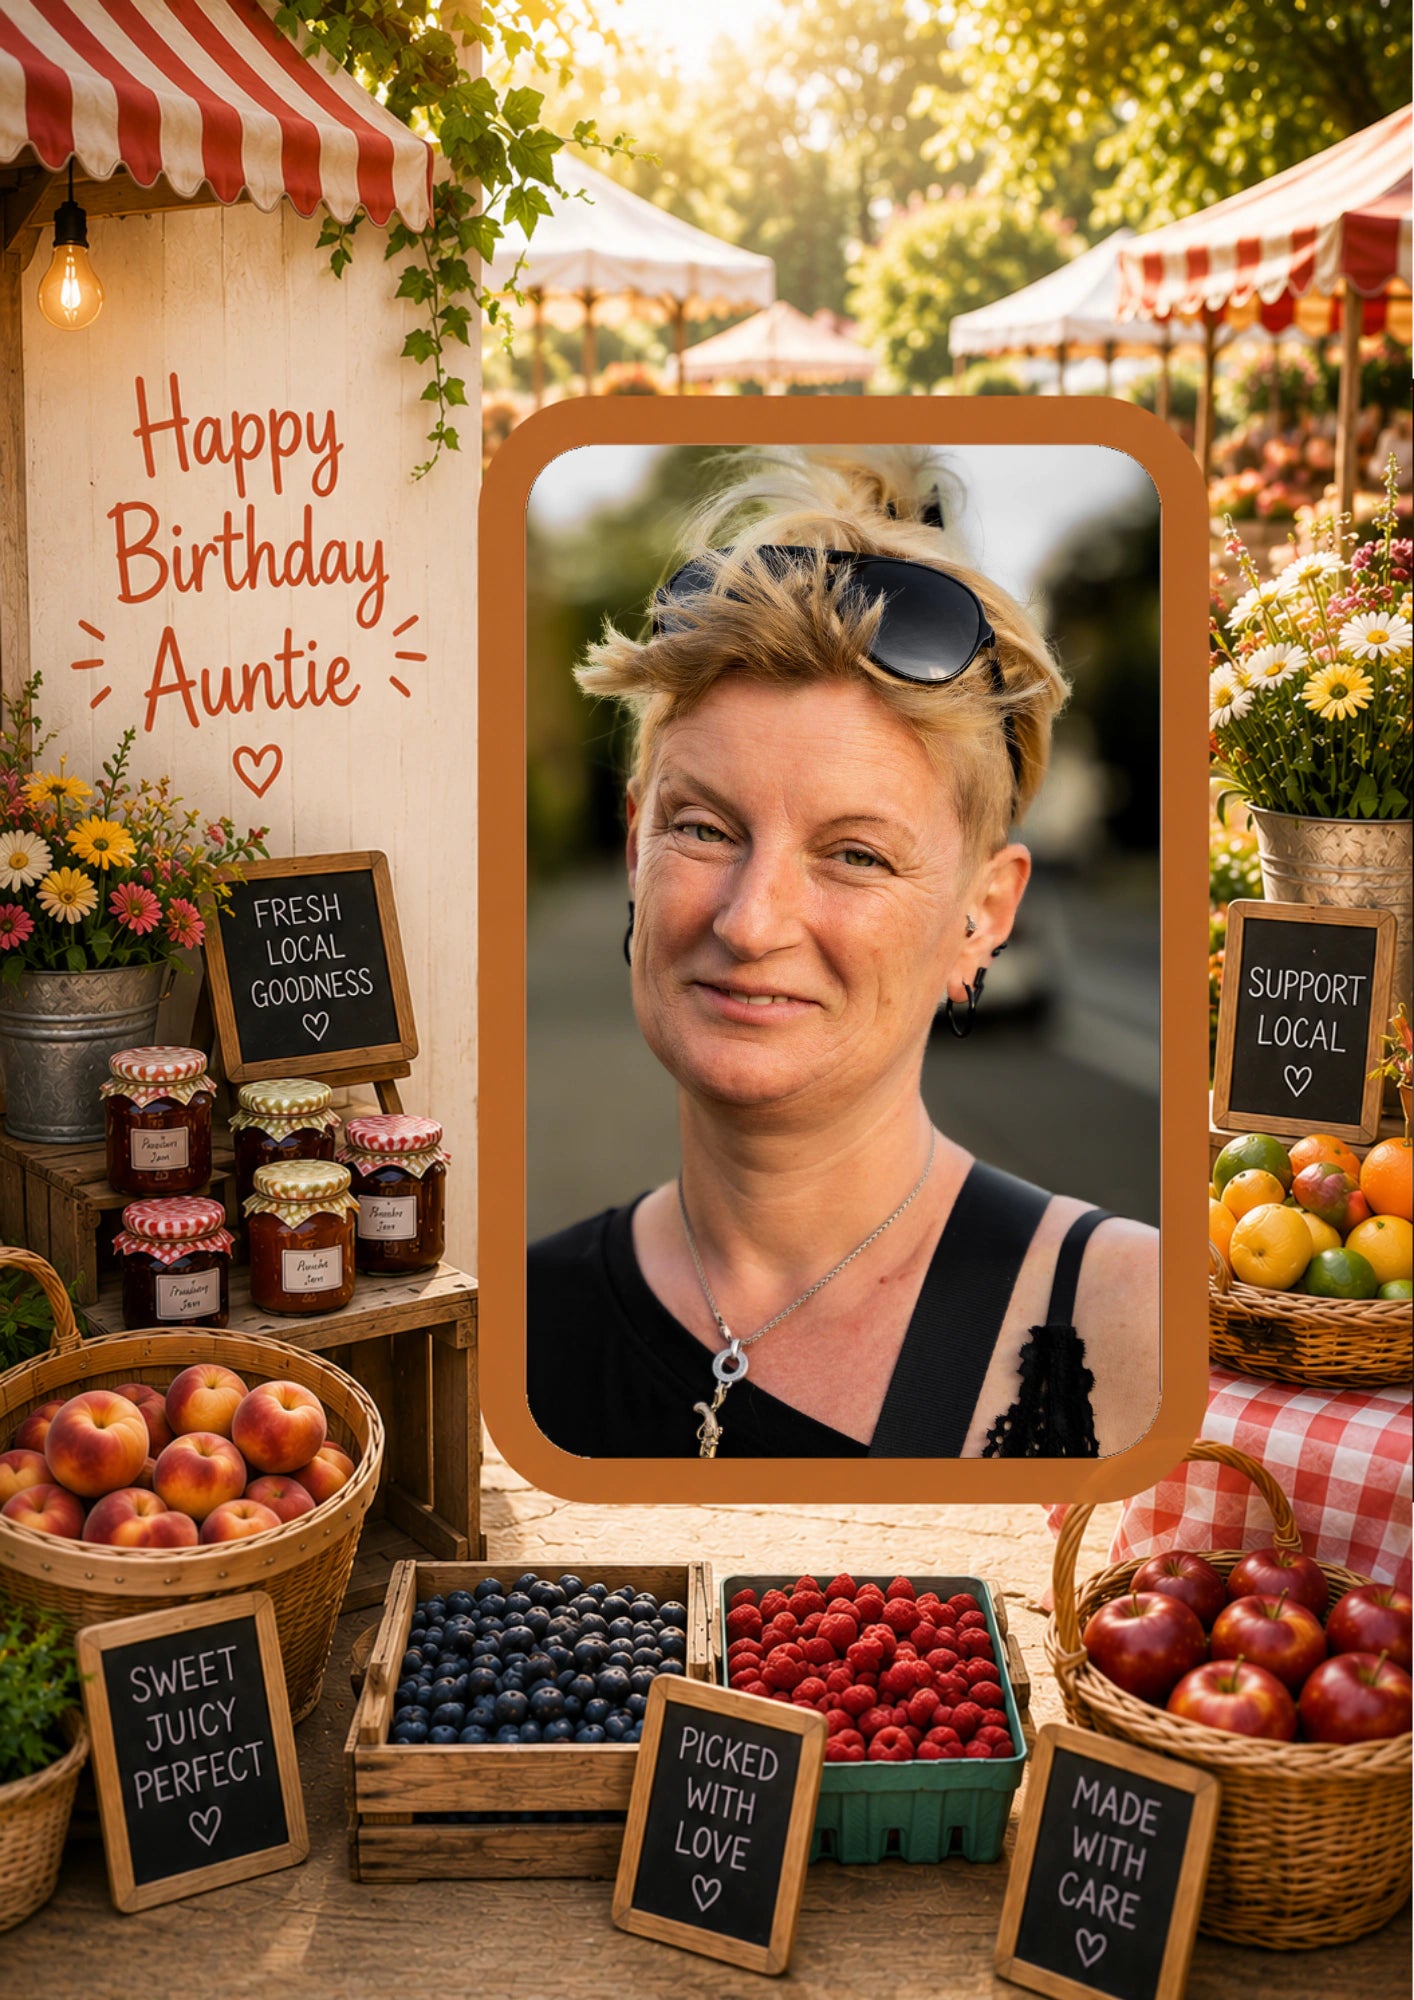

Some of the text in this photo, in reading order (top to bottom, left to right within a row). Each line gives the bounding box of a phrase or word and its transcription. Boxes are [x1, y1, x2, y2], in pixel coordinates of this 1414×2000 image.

[132, 371, 344, 499] Happy
[106, 501, 390, 630] Birthday
[144, 625, 361, 733] Auntie
[253, 892, 342, 929] FRESH
[266, 933, 347, 966] LOCAL
[251, 967, 374, 1008] GOODNESS
[1248, 966, 1367, 1007] SUPPORT
[1257, 1014, 1347, 1053] LOCAL
[130, 1644, 237, 1704] SWEET
[146, 1696, 236, 1752] JUICY
[133, 1740, 264, 1809] PERFECT
[679, 1726, 779, 1782] PICKED
[687, 1776, 756, 1825] WITH
[1071, 1775, 1162, 1837] MADE
[674, 1820, 751, 1871] LOVE
[1073, 1825, 1147, 1881] WITH
[1058, 1871, 1141, 1930] CARE
